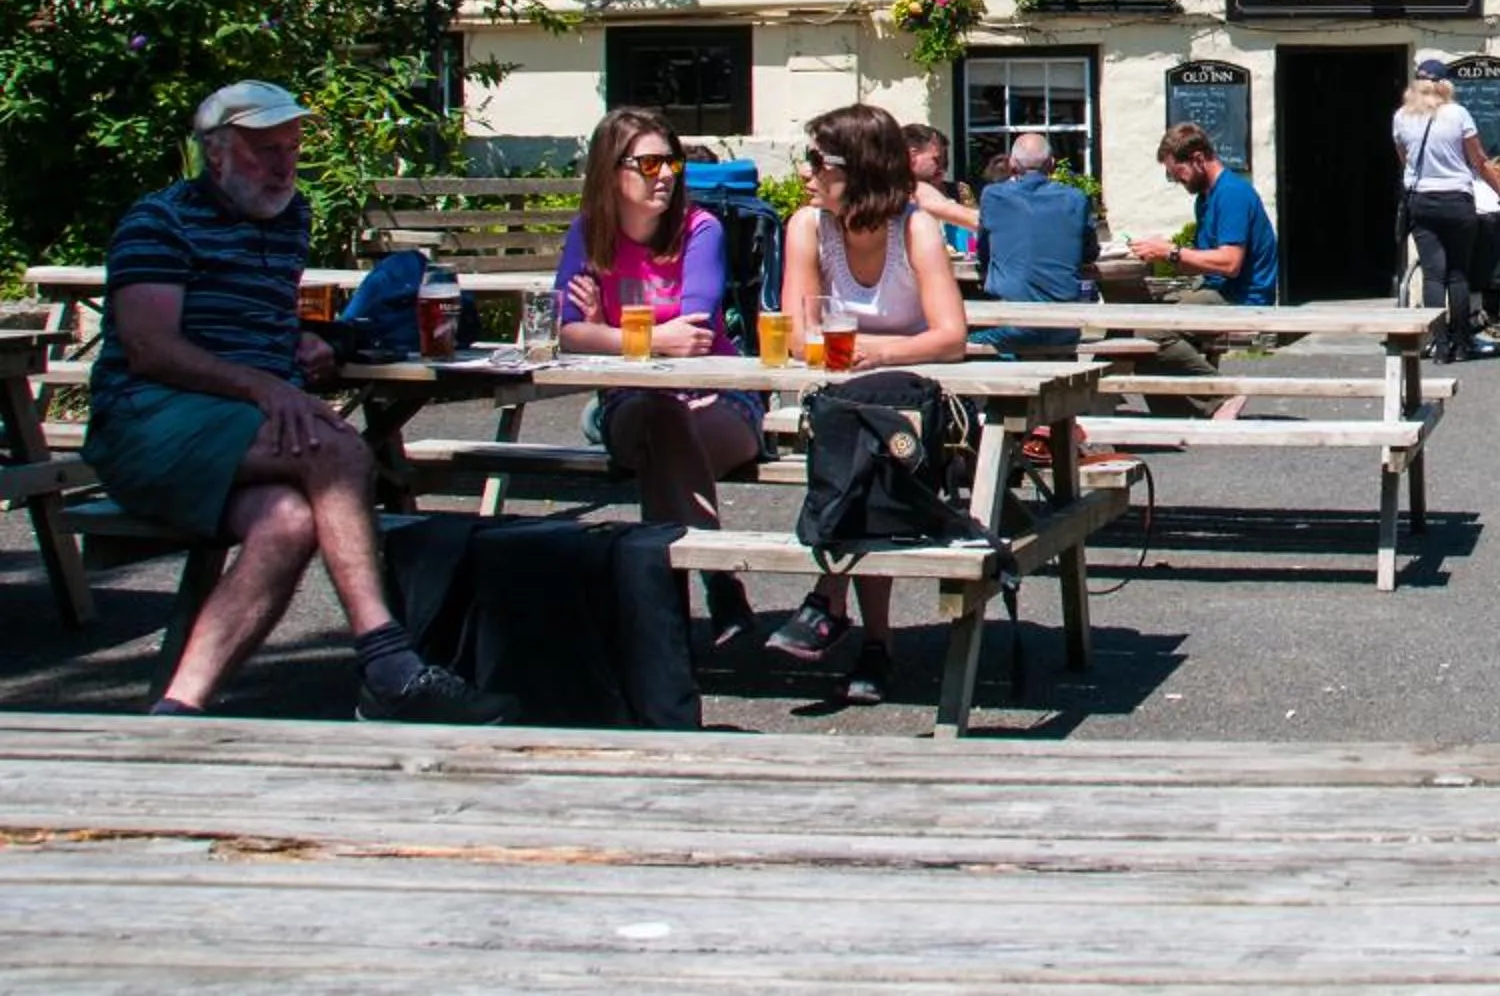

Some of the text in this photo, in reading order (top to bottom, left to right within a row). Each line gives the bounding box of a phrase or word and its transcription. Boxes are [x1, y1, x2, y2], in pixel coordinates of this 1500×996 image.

[1183, 71, 1233, 83] OLD INN
[1458, 67, 1483, 77] OLD
